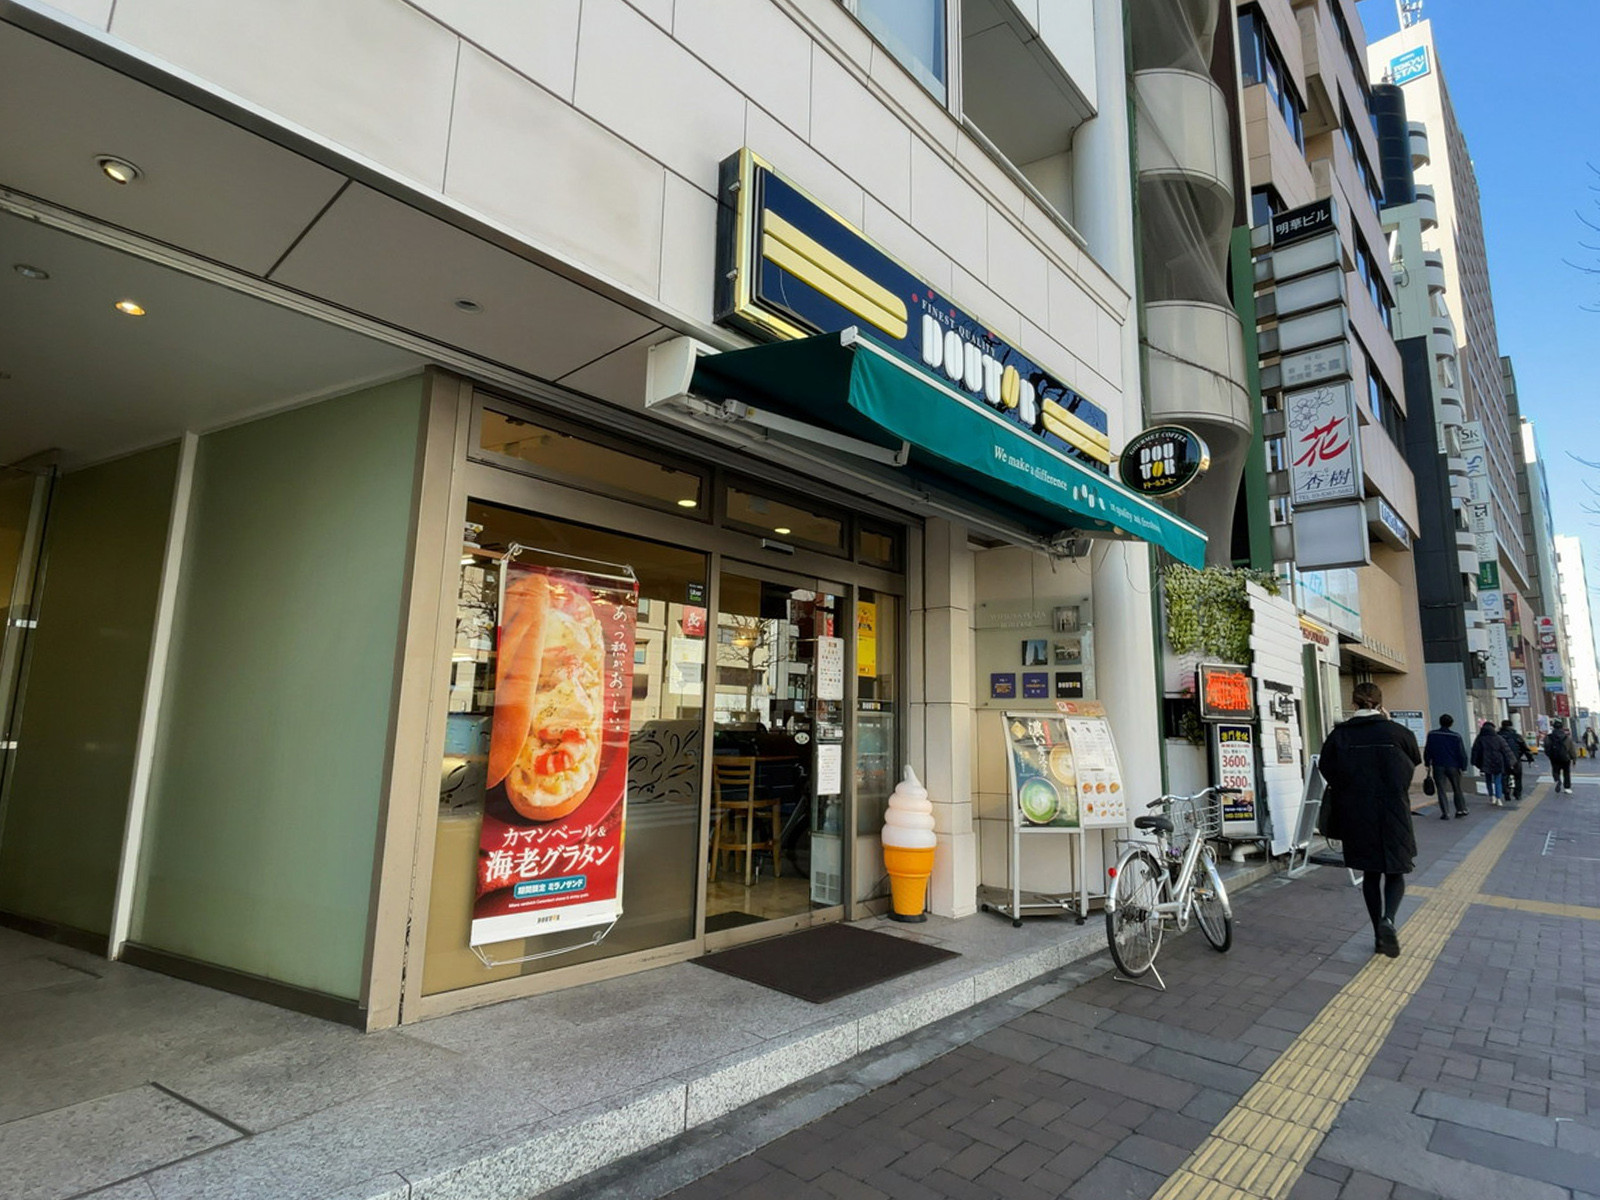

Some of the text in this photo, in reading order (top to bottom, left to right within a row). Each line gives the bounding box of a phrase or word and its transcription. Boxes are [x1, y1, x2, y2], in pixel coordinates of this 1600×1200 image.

[1393, 55, 1425, 72] TOKYU
[1394, 61, 1425, 80] STAY
[1275, 209, 1329, 236] 明華ビル
[922, 299, 996, 357] FINEST QUALITY
[921, 313, 1040, 426] DOUTOR
[1128, 431, 1188, 456] GOURMET COFFEE
[1140, 442, 1175, 465] DOU
[1292, 415, 1352, 468] 花
[994, 445, 1007, 464] We
[1008, 457, 1030, 474] make
[1035, 466, 1068, 492] difference
[1139, 458, 1176, 480] TOR
[501, 824, 607, 848] カマンベール&
[485, 843, 615, 883] 海老グラタン
[517, 878, 584, 895] 期間限定 ミラノサンド
